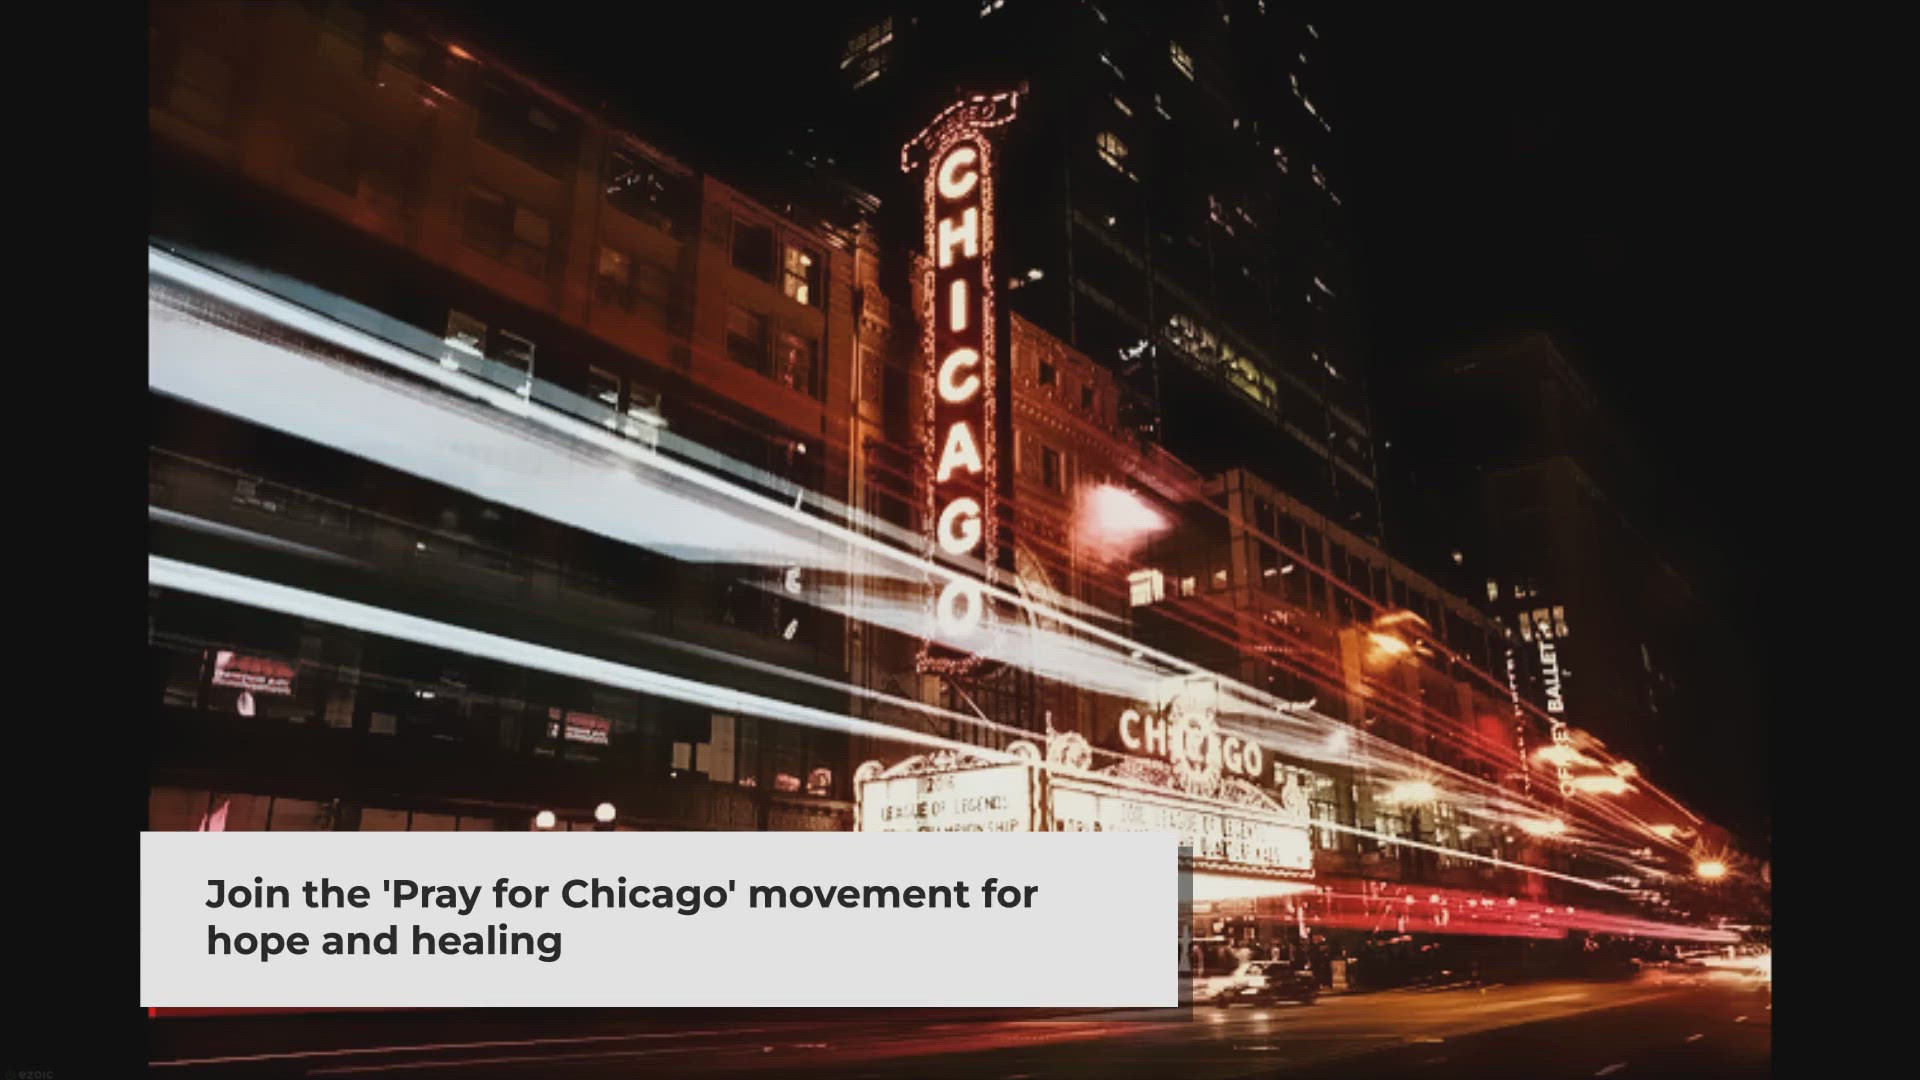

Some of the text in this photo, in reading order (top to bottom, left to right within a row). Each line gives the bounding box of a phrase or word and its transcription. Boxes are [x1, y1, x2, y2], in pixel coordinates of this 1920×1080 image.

[935, 147, 983, 636] CHICAGO
[1539, 638, 1566, 714] BALLET
[1119, 708, 1263, 777] CHGO
